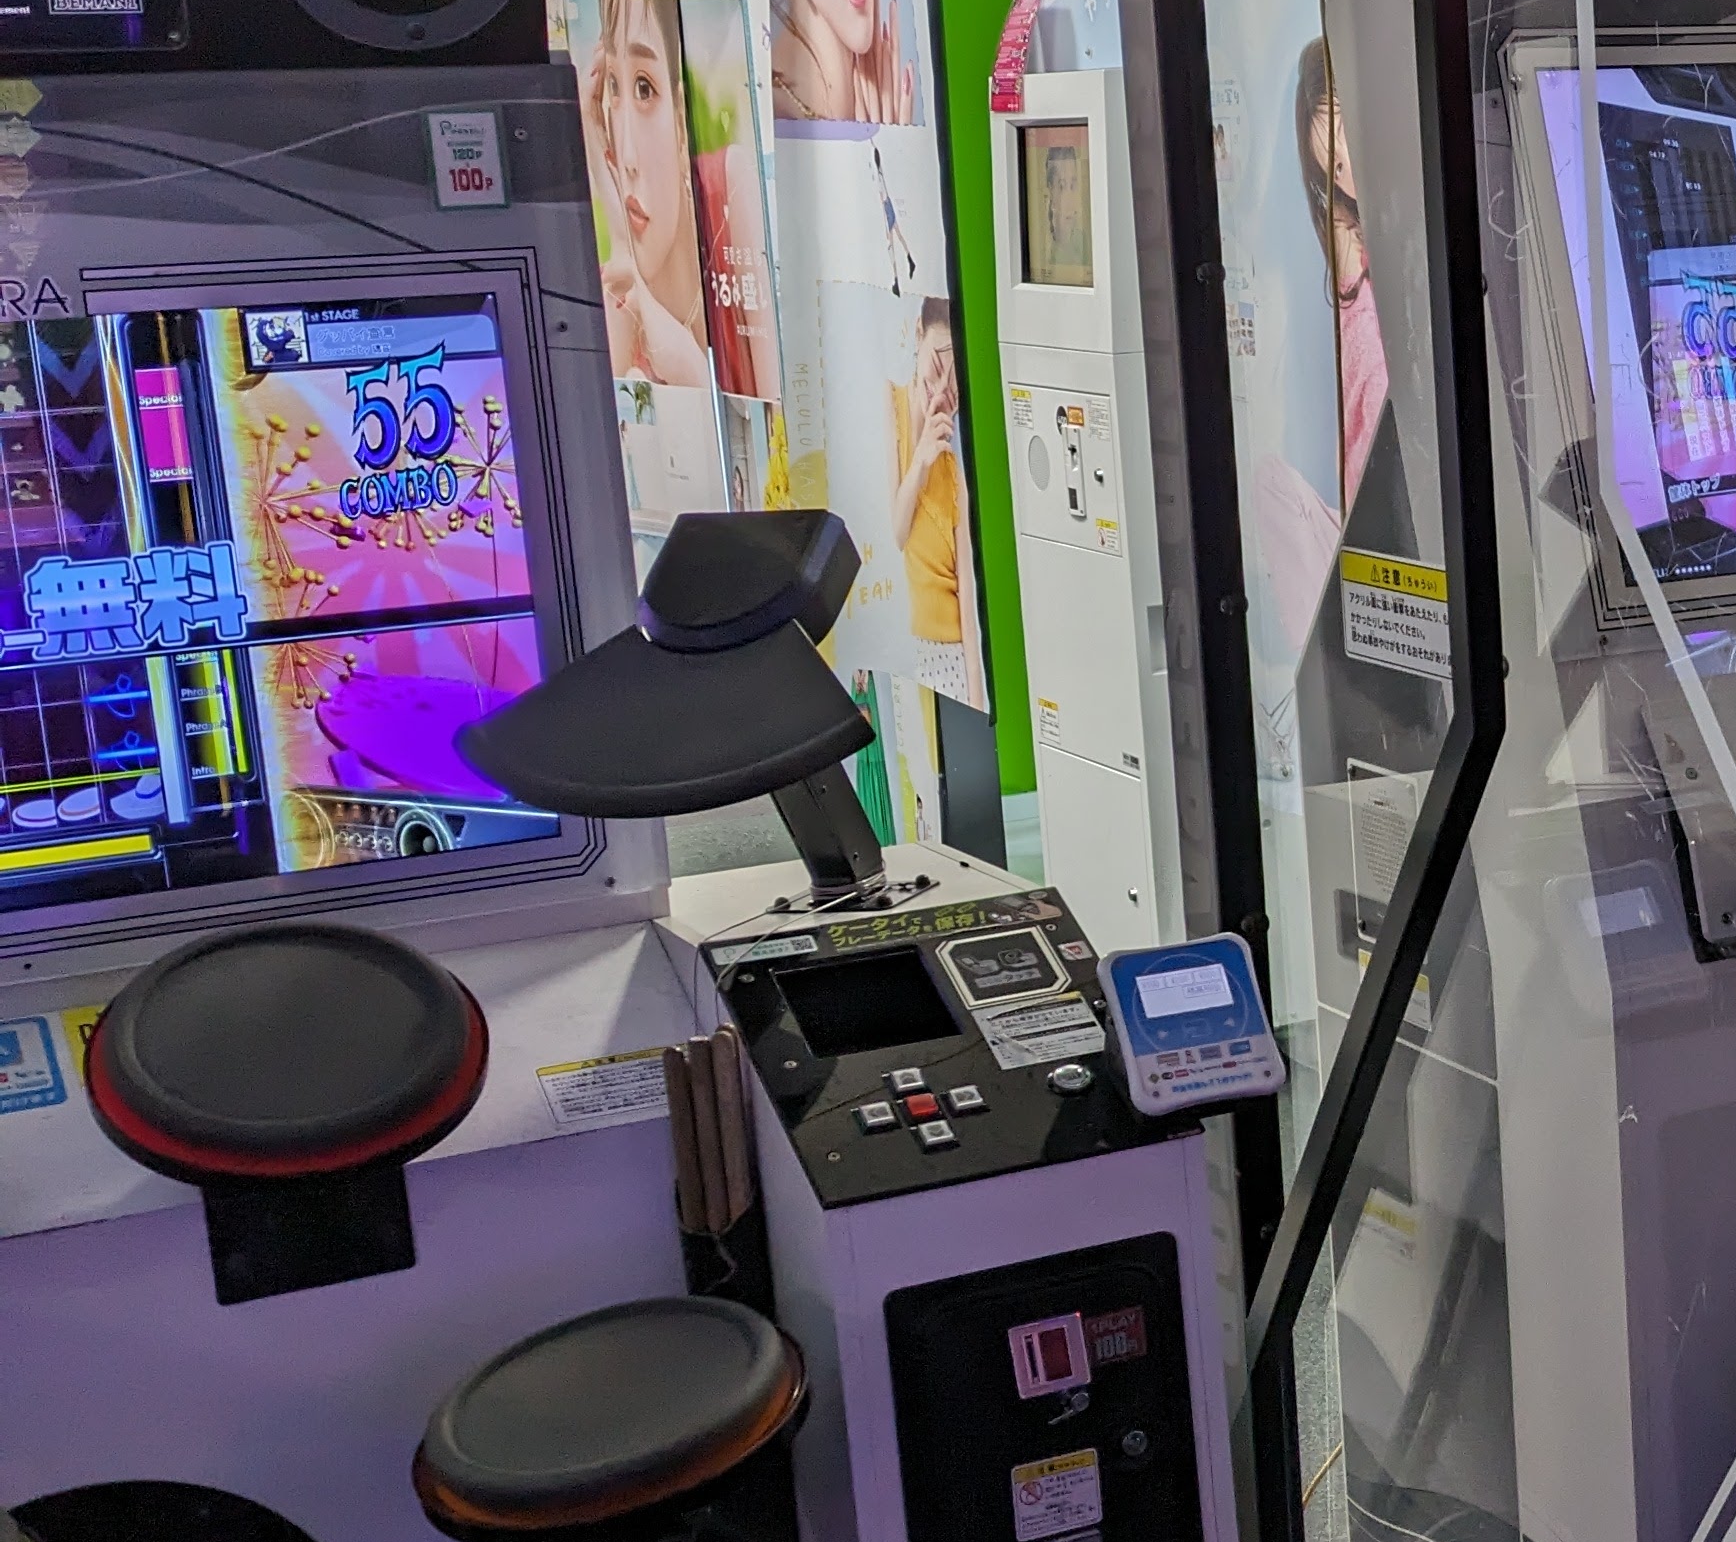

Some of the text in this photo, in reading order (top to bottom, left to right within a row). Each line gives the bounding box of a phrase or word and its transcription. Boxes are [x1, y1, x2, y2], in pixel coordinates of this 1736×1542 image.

[321, 308, 360, 322] STAGE
[344, 339, 457, 470] 55
[339, 462, 459, 521] COMBO
